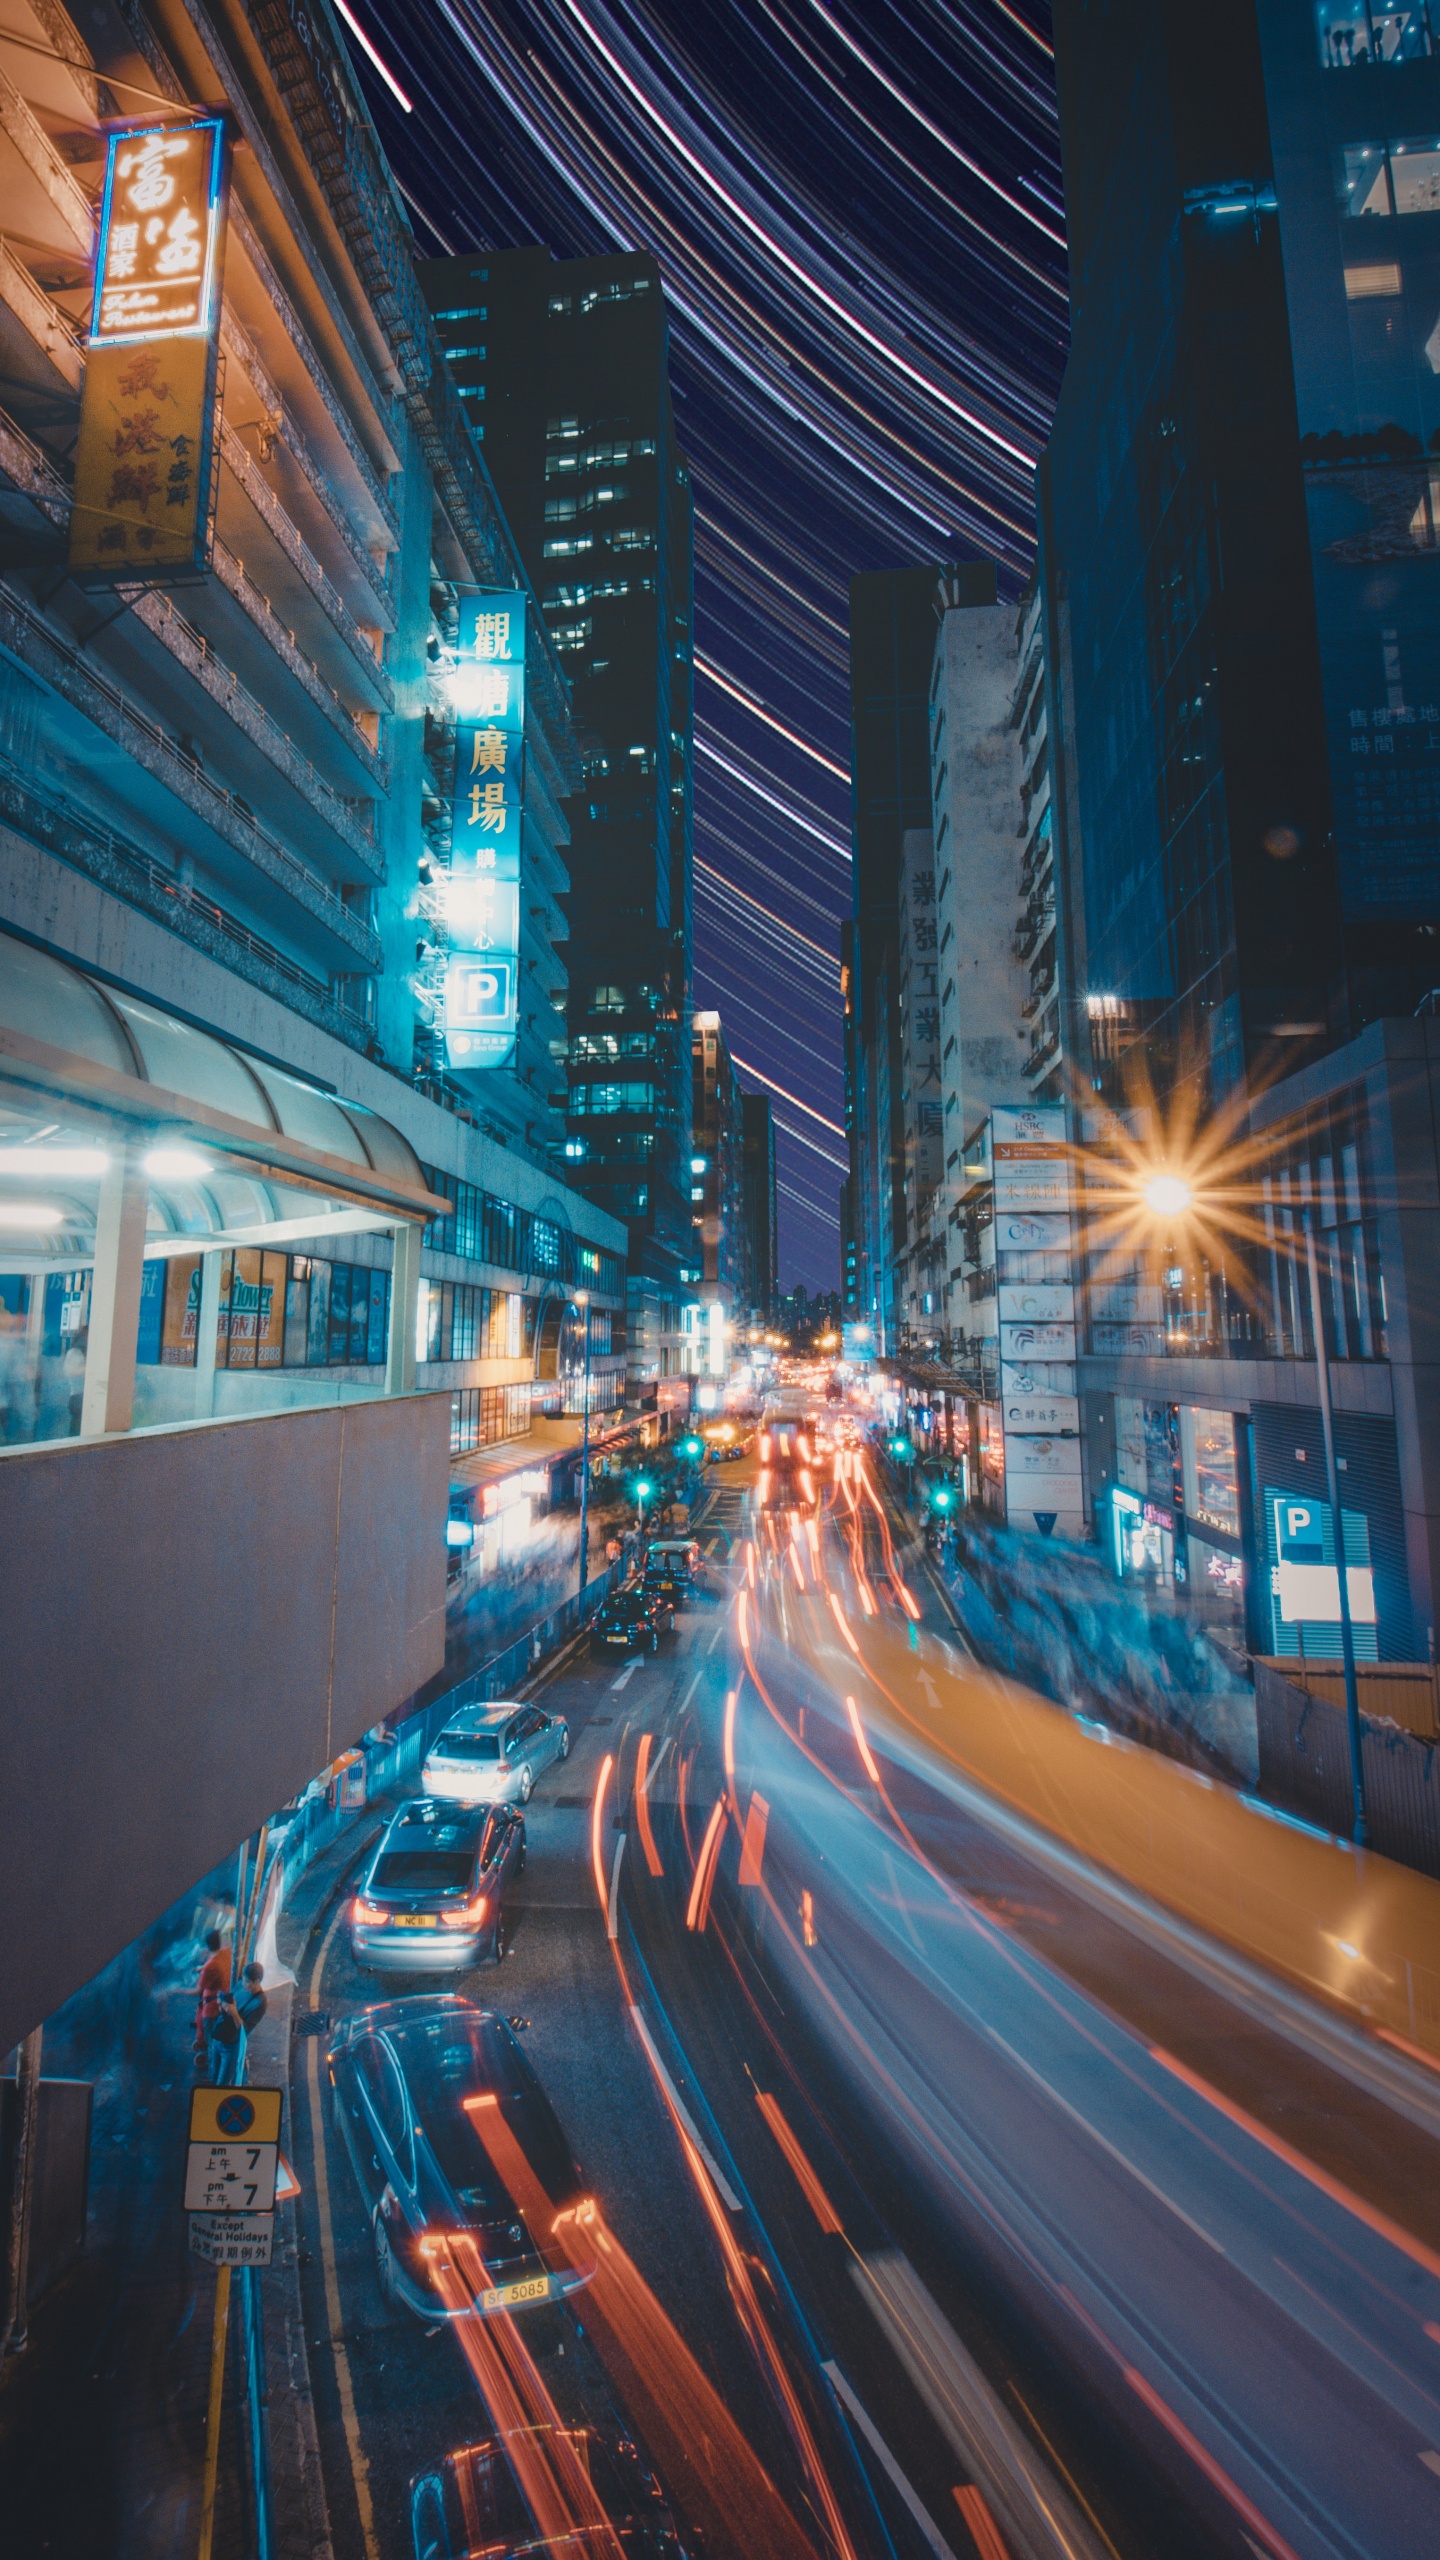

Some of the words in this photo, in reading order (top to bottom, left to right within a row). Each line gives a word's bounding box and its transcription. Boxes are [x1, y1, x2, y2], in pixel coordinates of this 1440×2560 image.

[108, 223, 139, 278] 酒家
[467, 612, 512, 834] 觀塘廣場
[467, 974, 498, 1013] P
[1015, 1122, 1045, 1131] HSBC
[230, 1346, 255, 1361] 2722
[258, 1346, 281, 1361] 2888
[1287, 1508, 1310, 1536] P
[405, 1917, 416, 1925] NC
[205, 2158, 230, 2170] 上午
[246, 2149, 260, 2170] 7
[203, 2194, 227, 2205] 下午
[208, 2183, 224, 2192] pm
[243, 2184, 257, 2206] 7
[211, 2220, 244, 2231] Except
[226, 2232, 268, 2244] Holidays
[511, 2281, 544, 2300] 5085
